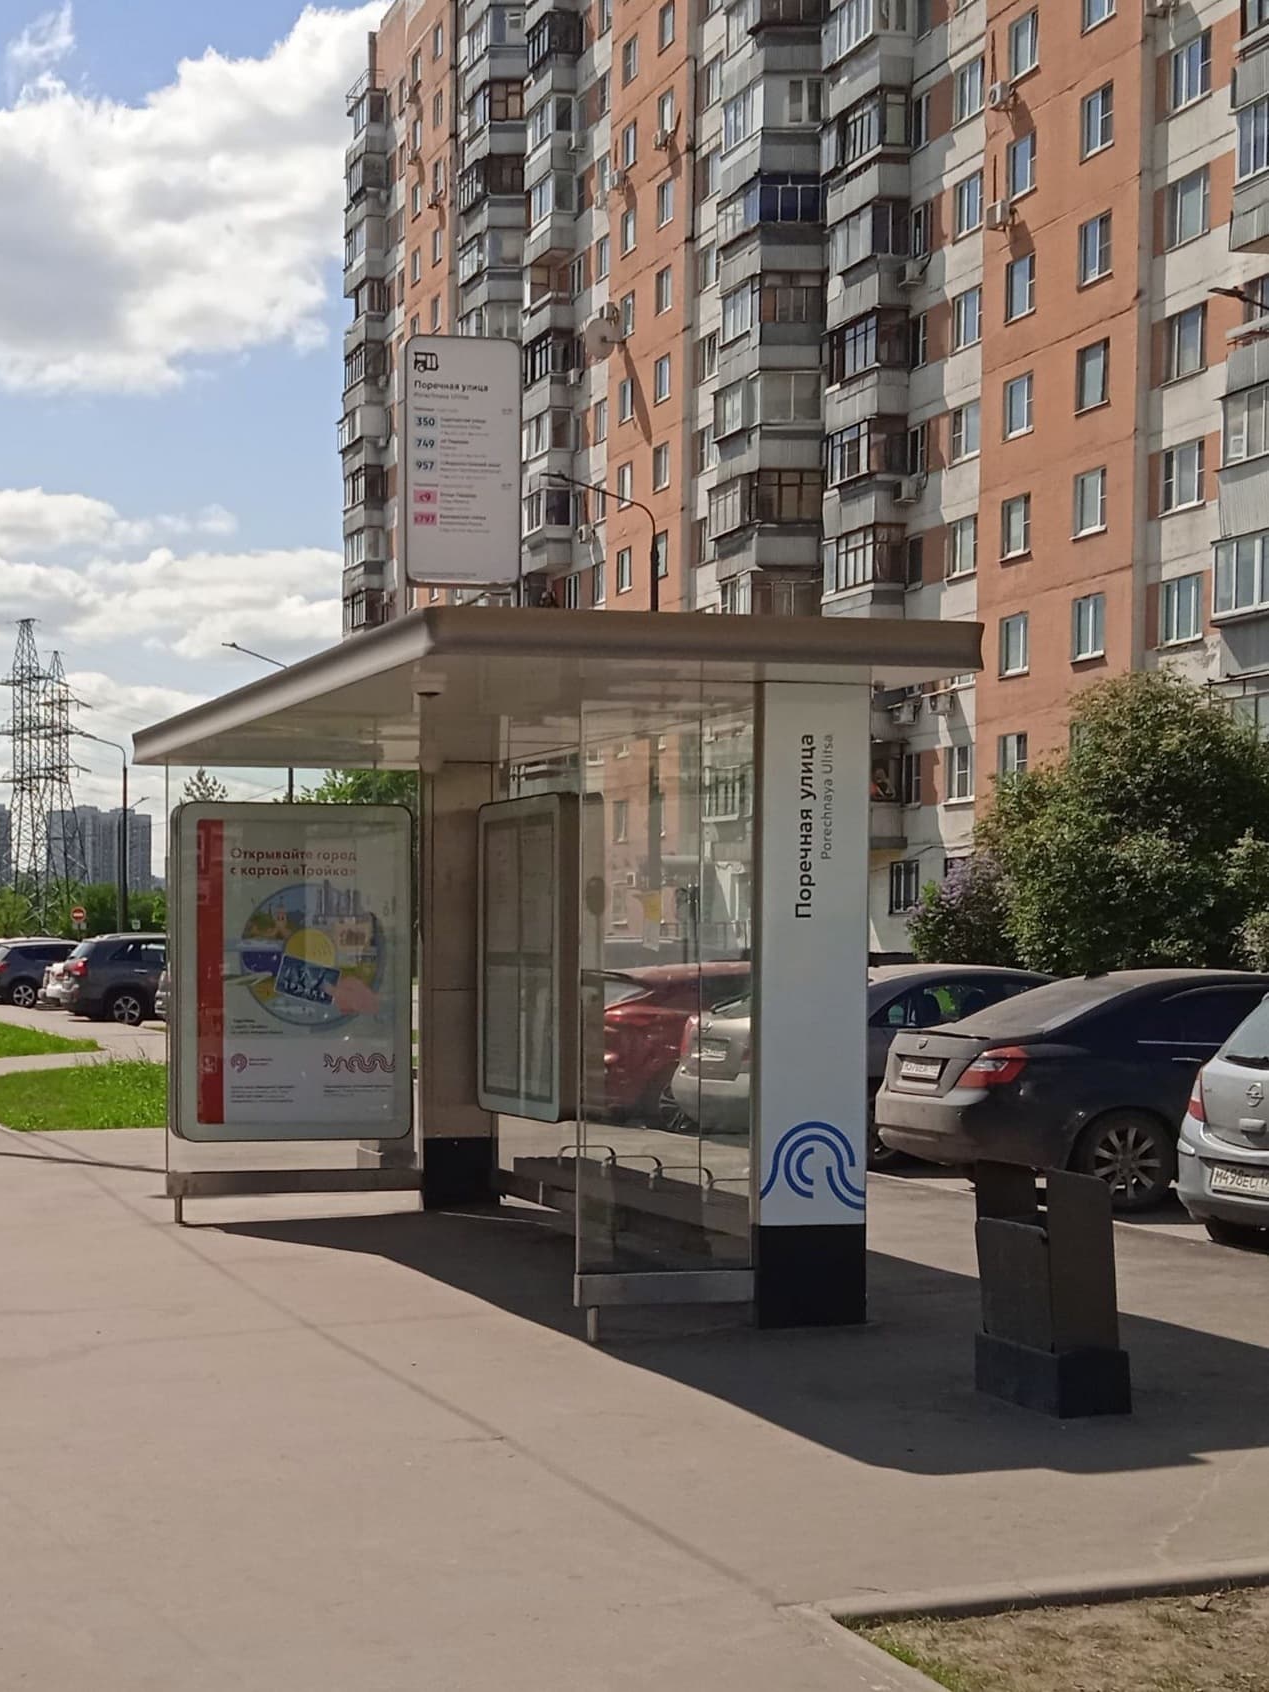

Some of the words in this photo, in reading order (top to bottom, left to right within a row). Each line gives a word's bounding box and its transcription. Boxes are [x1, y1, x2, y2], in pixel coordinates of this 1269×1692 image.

[414, 380, 460, 391] Поречная
[461, 383, 489, 393] улица
[415, 416, 436, 427] 350
[416, 438, 435, 449] 749
[415, 460, 435, 471] 957
[821, 734, 834, 774] Ulitsa
[800, 733, 817, 801] улица
[821, 778, 835, 860] Porechnaya
[230, 847, 313, 862] Открывайте
[317, 851, 357, 863] город
[241, 864, 289, 878] картой
[795, 808, 816, 919] Поречная
